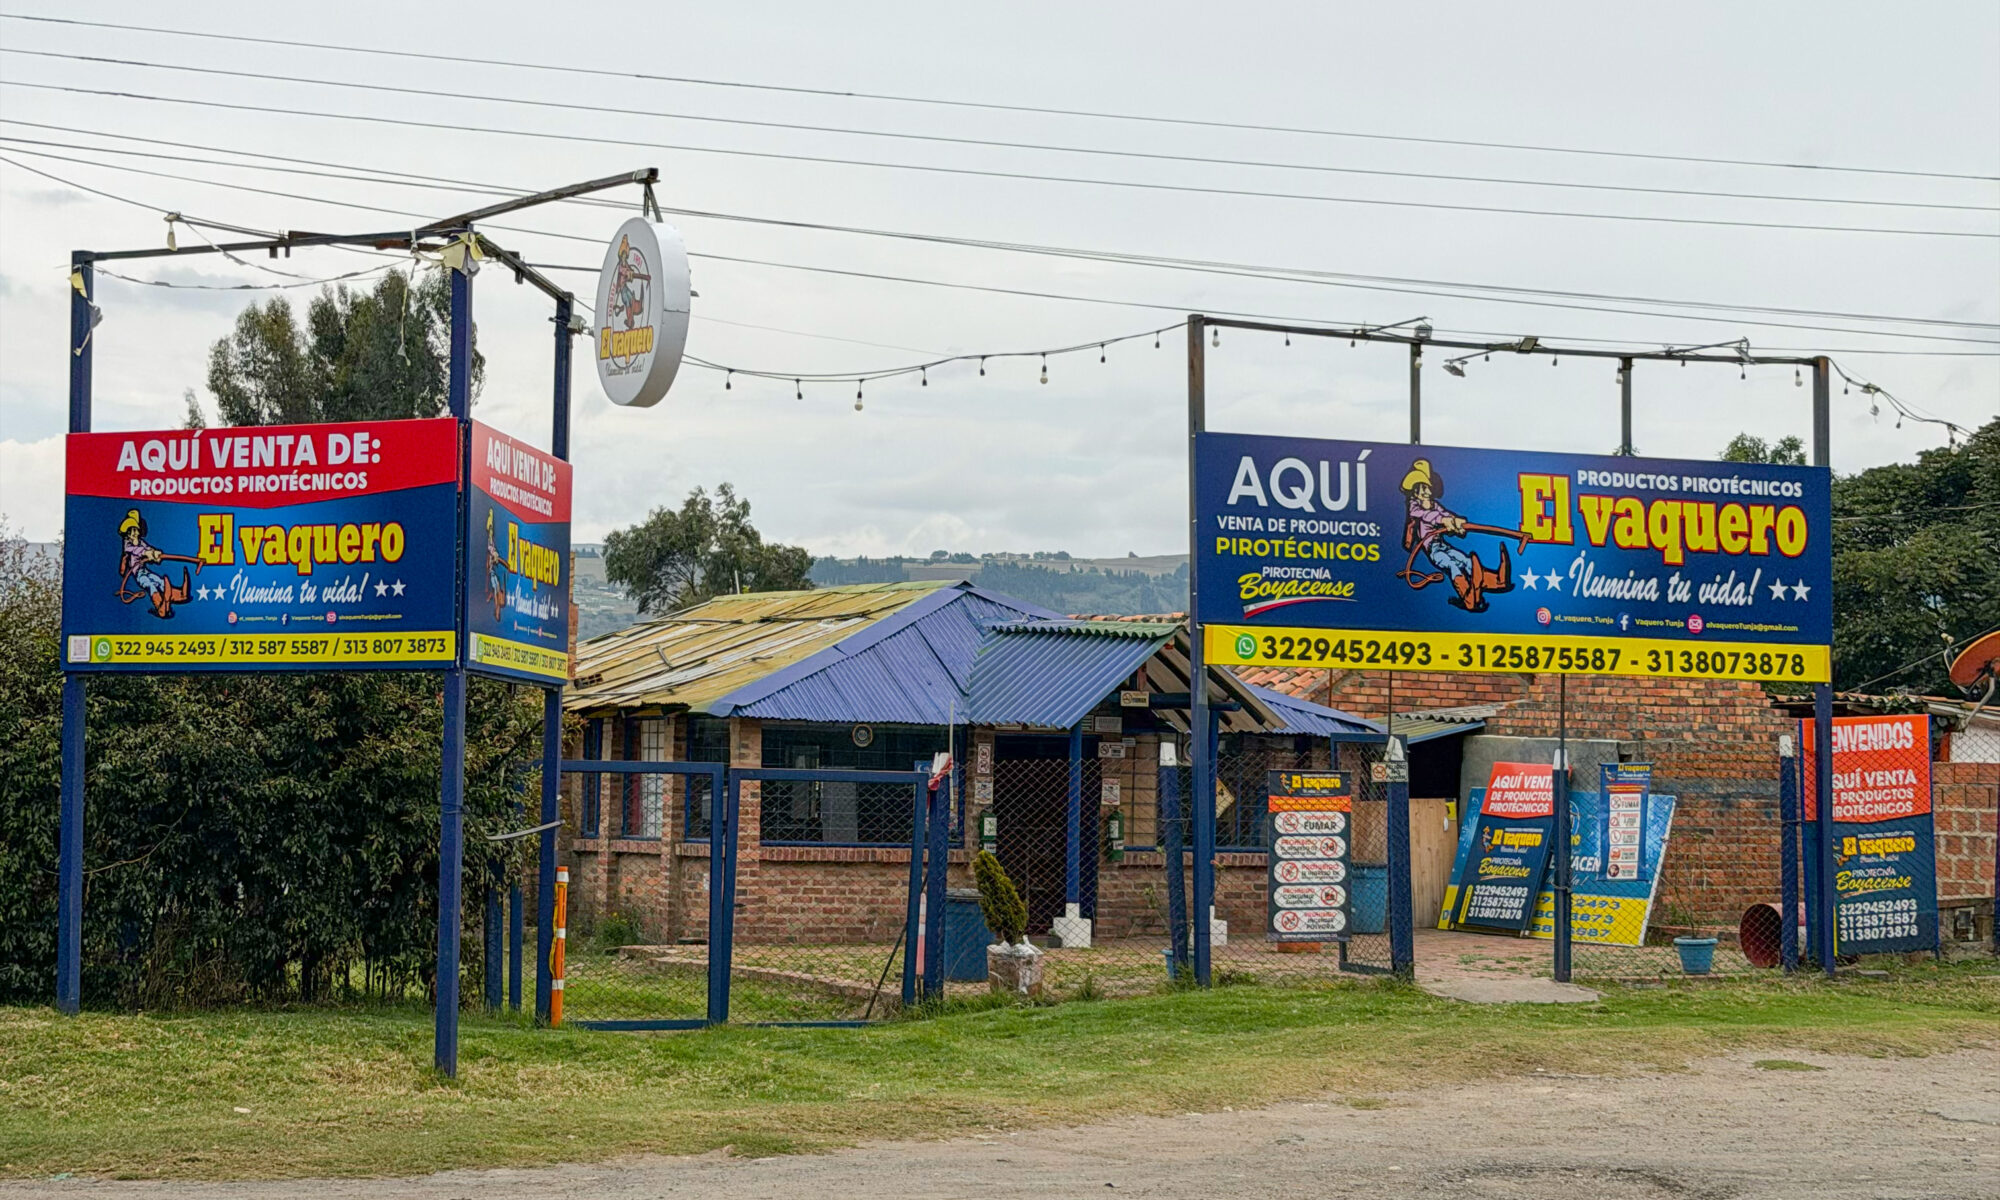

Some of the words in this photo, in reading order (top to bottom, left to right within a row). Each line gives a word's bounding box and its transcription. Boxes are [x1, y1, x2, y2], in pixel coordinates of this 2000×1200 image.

[600, 326, 611, 360] El
[612, 325, 653, 364] vaquero
[116, 430, 203, 473] AQUÍ
[210, 435, 318, 469] VENTA
[328, 432, 381, 465] DE:
[486, 437, 512, 476] AQUÍ
[513, 447, 540, 489] VENTA
[542, 461, 556, 496] DE:
[130, 476, 233, 496] PRODUCTOS
[238, 470, 367, 493] PIROTÉCNICOS
[490, 476, 519, 504] PRODUCTOS
[1227, 450, 1372, 512] AQUÍ
[1578, 470, 1678, 492] PRODUCTOS
[1682, 476, 1802, 498] PIROTÉCNICOS
[1217, 515, 1264, 531] VENTA
[1267, 518, 1286, 533] DE
[1290, 520, 1380, 537] PRODUCTOS:
[1518, 473, 1575, 546] El
[1578, 494, 1808, 566] vaquero
[198, 513, 234, 565] El
[239, 522, 405, 575] vaquero
[1216, 536, 1380, 561] PIROTÉCNICOS
[508, 521, 518, 575] El
[519, 539, 560, 591] vaquero
[1262, 566, 1331, 580] PIROTECNÍA
[300, 579, 317, 604] tu
[322, 572, 369, 603] vida!
[1238, 572, 1355, 600] Boyacense
[1667, 570, 1692, 603] tu
[1699, 567, 1761, 606] vida!
[1635, 618, 1664, 627] Vaquero
[1665, 619, 1684, 629] Tunja
[115, 641, 142, 655] 322
[145, 641, 174, 655] 945
[178, 640, 215, 655] 2493
[230, 640, 254, 655] 312
[258, 640, 286, 654] 587
[291, 639, 329, 654] 5587
[343, 639, 368, 654] 313
[372, 638, 403, 654] 807
[407, 638, 446, 653] 3873
[1262, 635, 1432, 665] 3229452493
[1458, 643, 1621, 672] 3125875587
[1647, 650, 1805, 676] 3138073878
[1832, 721, 1913, 753] ENVENIDOS
[1302, 777, 1341, 791] vaquero
[1492, 771, 1524, 789] AQUÍ
[1832, 767, 1861, 789] QUÍ
[1864, 769, 1917, 787] VENTA
[1490, 791, 1503, 801] DE
[1503, 791, 1553, 801] PRODUCTOS
[1841, 787, 1914, 803] PRODUCTOS
[1489, 801, 1549, 813] PIROTÉCNICOS
[1832, 801, 1913, 818] IROTÉCNICOS
[1304, 821, 1337, 830] FUMAR
[1492, 829, 1503, 845] El
[1503, 832, 1542, 851] vaquero
[1842, 836, 1857, 855] El
[1859, 837, 1915, 859] vaquero
[1479, 857, 1531, 877] Boyacense
[1852, 866, 1896, 877] PIROTECNÍA
[1474, 885, 1528, 897] 3229452493
[1836, 870, 1911, 893] Boyacense
[1468, 907, 1522, 919] 3138073878
[1471, 896, 1525, 908] 3125875587
[1839, 898, 1917, 915] 3229452493
[1839, 911, 1917, 929] 3125875587
[1840, 924, 1918, 942] 3138073878
